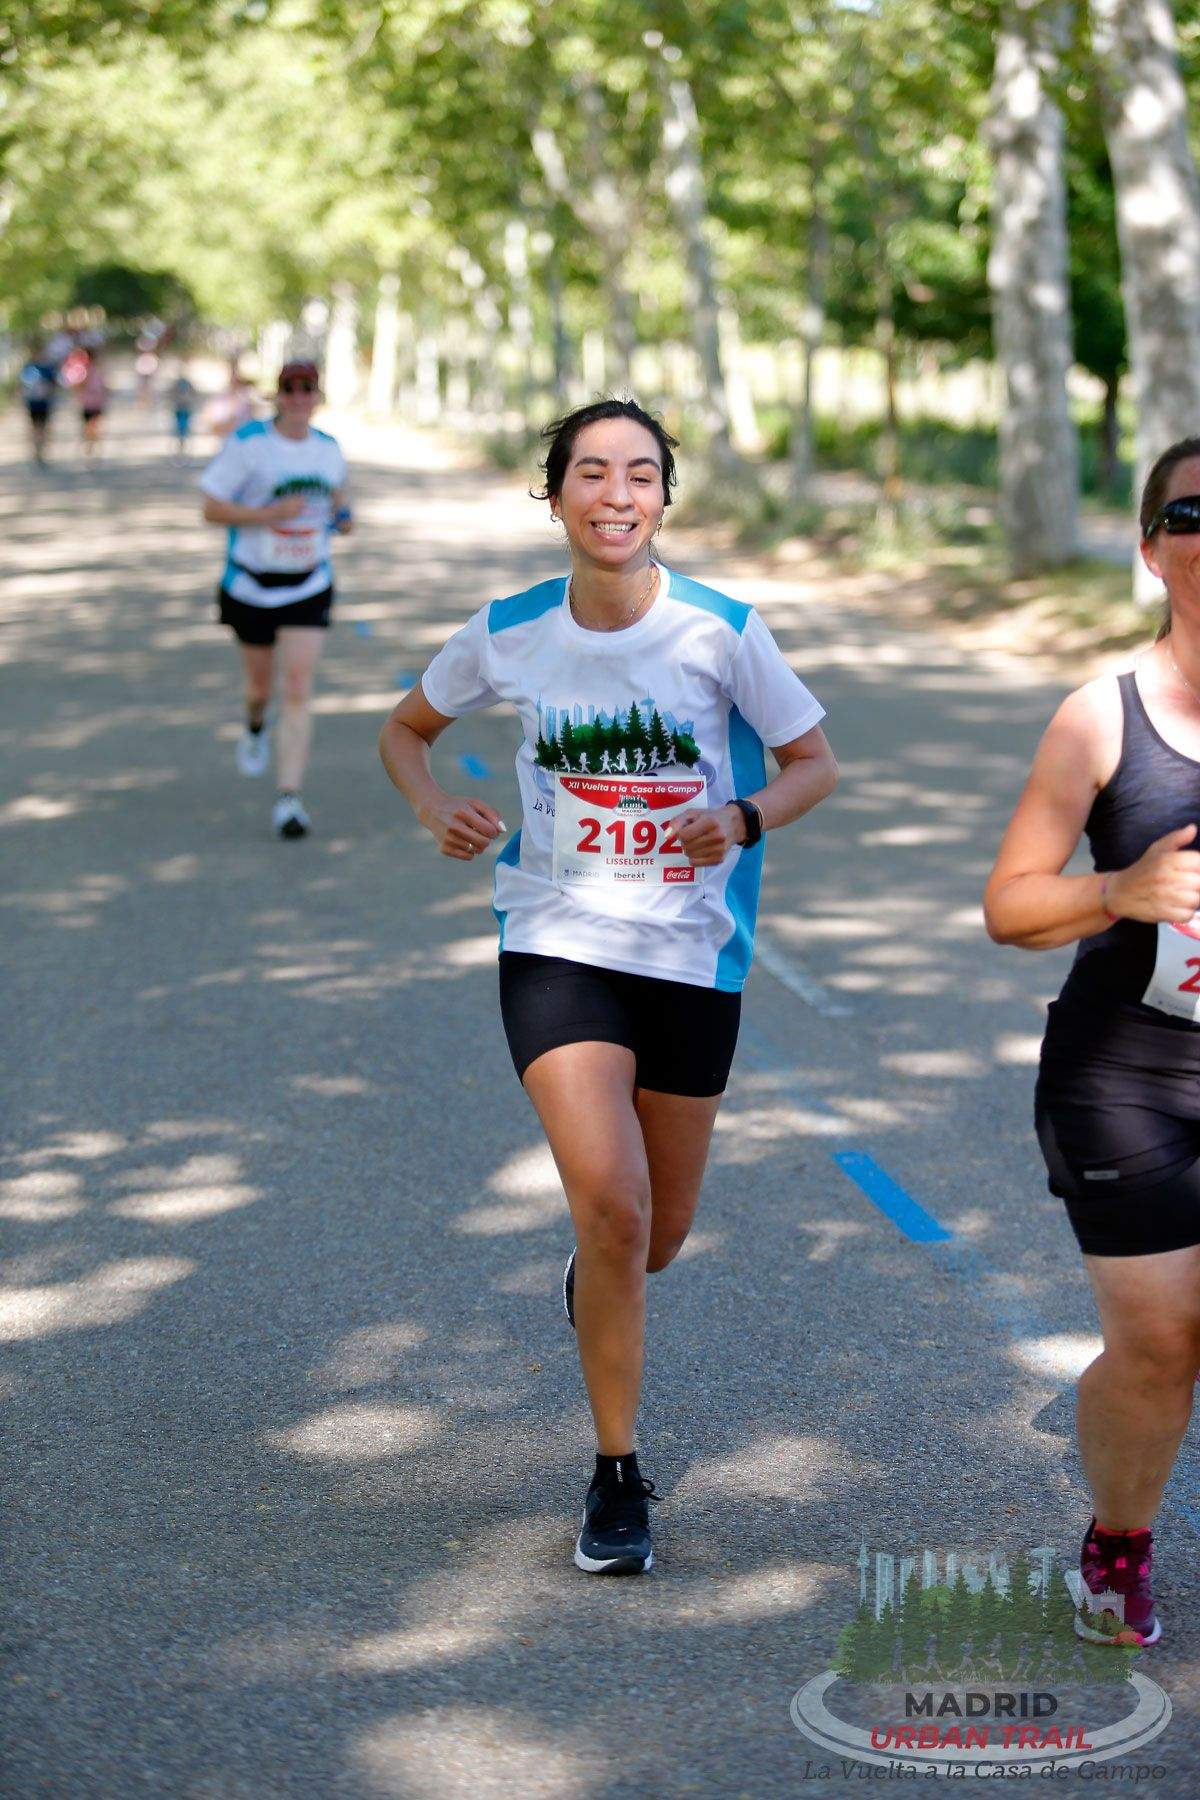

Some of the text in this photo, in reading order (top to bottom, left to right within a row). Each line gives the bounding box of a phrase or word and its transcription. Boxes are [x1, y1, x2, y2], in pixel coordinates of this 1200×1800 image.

[581, 782, 609, 791] Vuelta
[631, 785, 652, 793] Casa
[655, 785, 666, 793] de
[668, 785, 697, 794] Campo
[577, 818, 683, 855] 2192
[572, 870, 599, 878] MADRID
